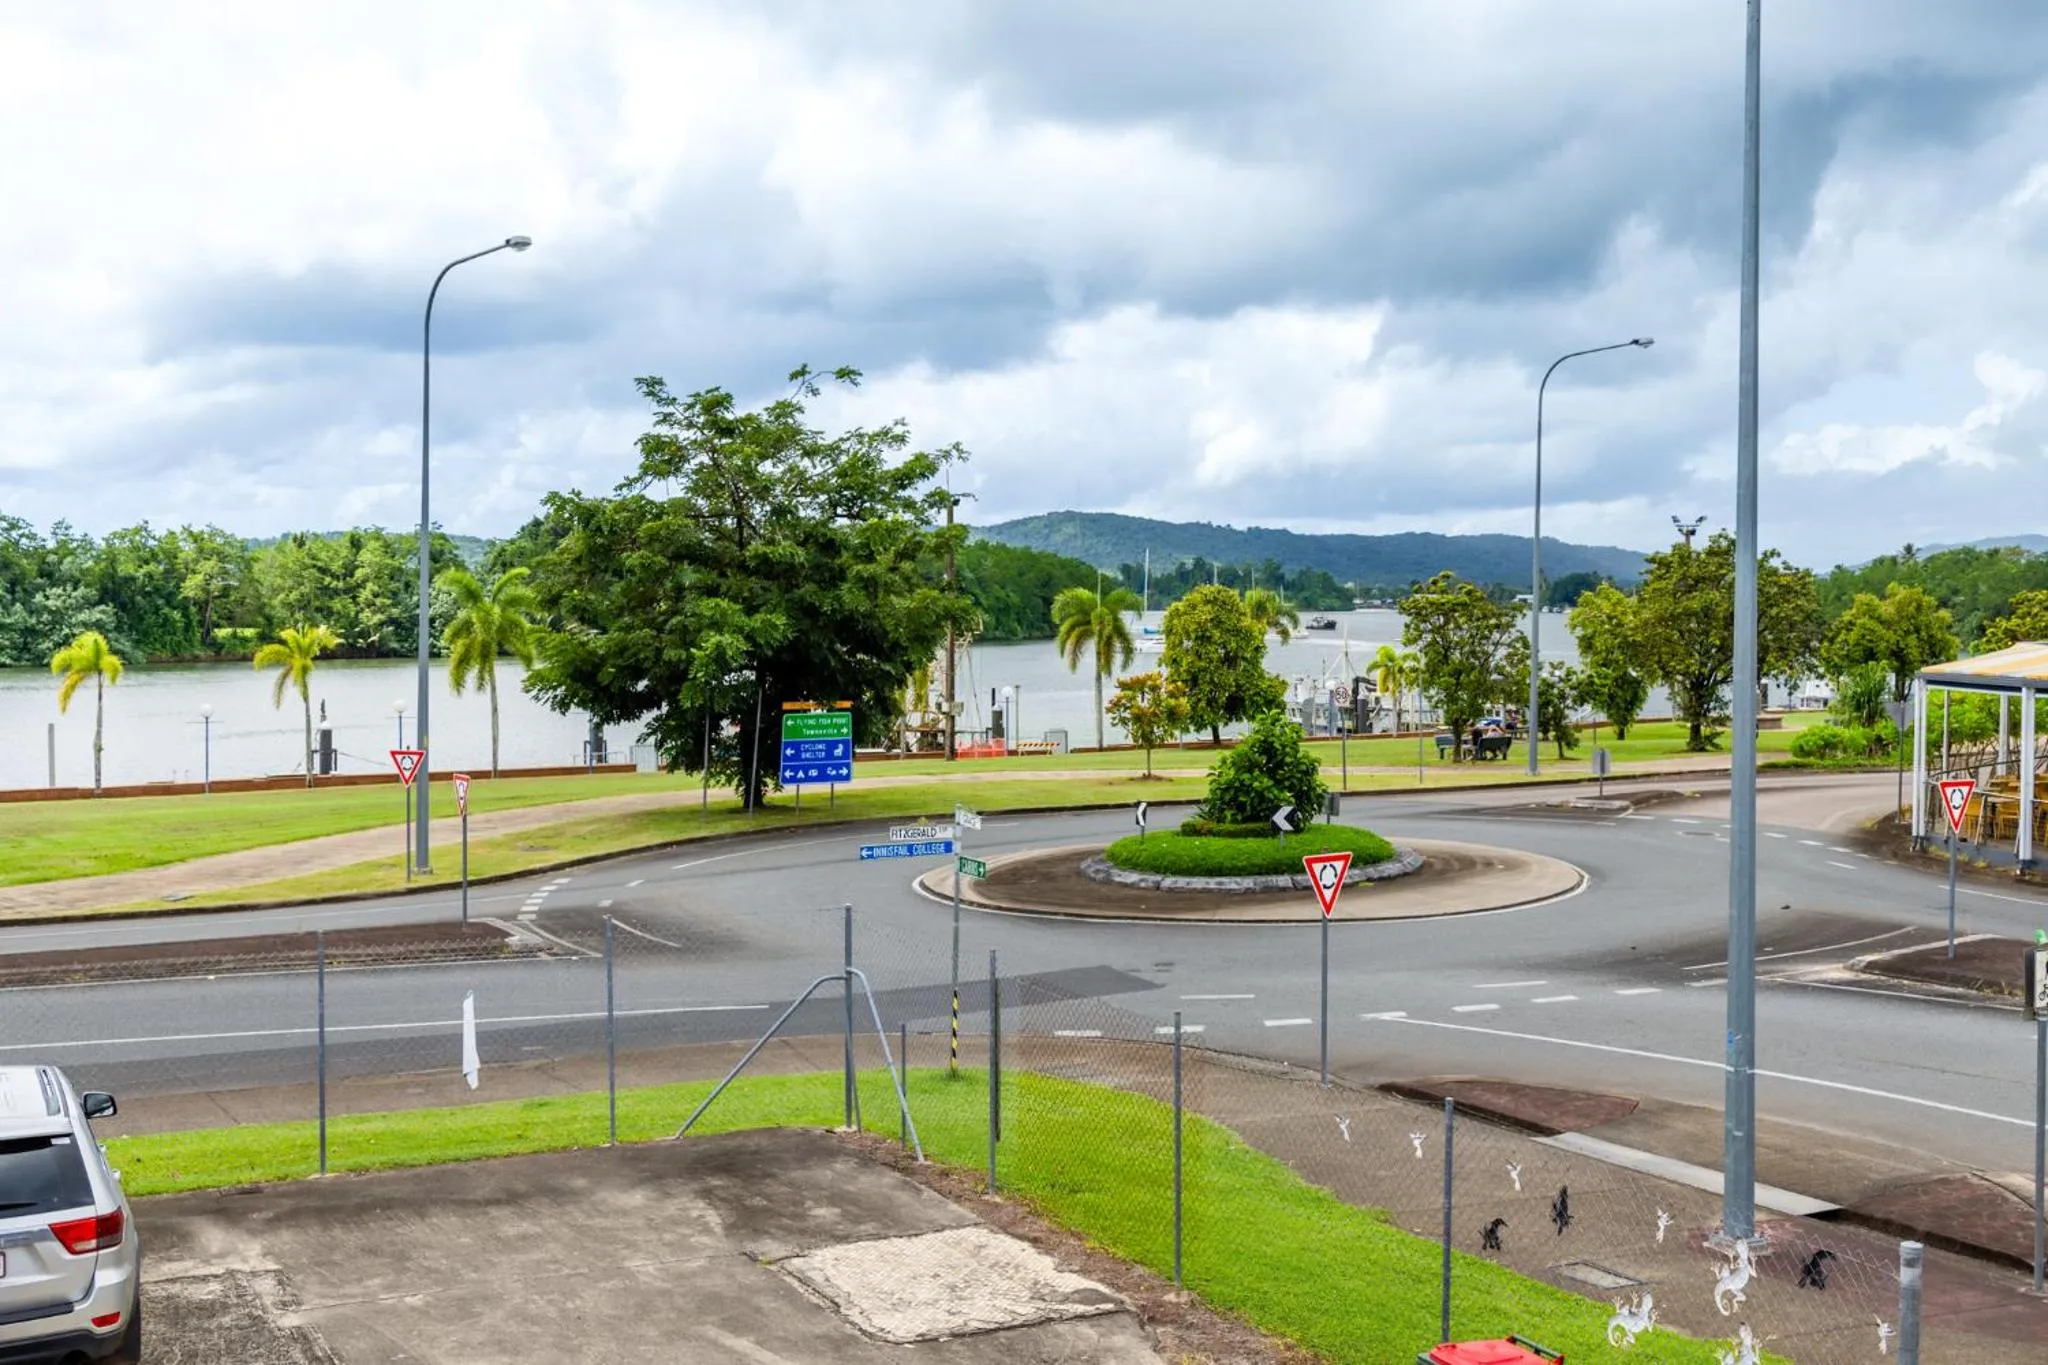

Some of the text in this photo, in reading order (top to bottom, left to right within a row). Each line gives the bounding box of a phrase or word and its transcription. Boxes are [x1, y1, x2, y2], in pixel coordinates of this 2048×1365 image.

[1336, 690, 1347, 699] 50
[800, 743, 827, 751] CYCLONE
[891, 827, 937, 839] FITZGERALD
[873, 842, 945, 858] INNISFAIL COLLEGE
